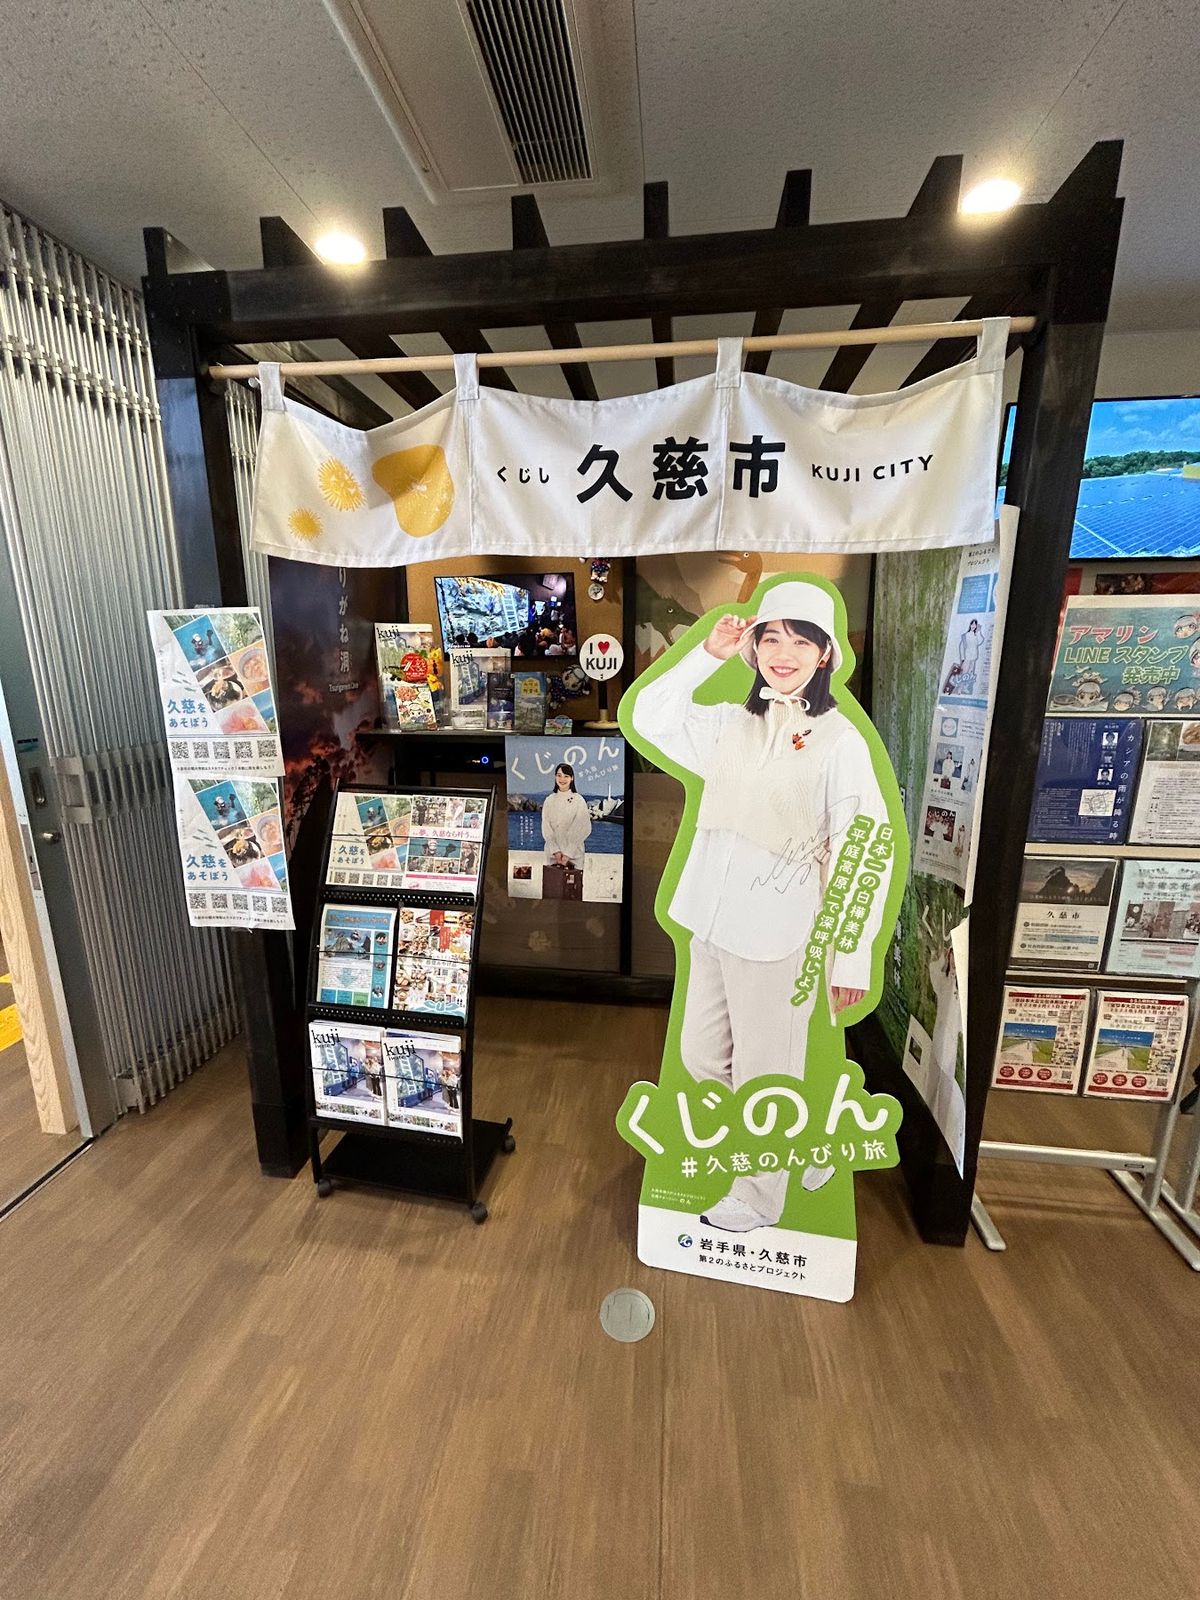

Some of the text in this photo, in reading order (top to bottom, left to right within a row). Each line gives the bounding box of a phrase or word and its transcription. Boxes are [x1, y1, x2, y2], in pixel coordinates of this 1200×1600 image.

[496, 434, 934, 504] くじし 久慈市 KUJI CITY
[376, 625, 401, 640] kuji
[1068, 624, 1160, 645] アマリン
[451, 650, 473, 665] kuji
[589, 642, 593, 655] I
[1063, 644, 1190, 665] LINE スタンプ
[585, 657, 617, 671] KUJI
[1121, 665, 1181, 686] 発売中
[167, 698, 207, 714] 久慈を
[169, 717, 208, 728] あそぼう
[511, 737, 619, 780] くじのん
[338, 845, 365, 856] 久慈を
[186, 854, 227, 868] 久慈を
[337, 856, 365, 864] あそぼう
[187, 871, 229, 881] あそぼう
[838, 828, 893, 950] 日本一の白樺美林
[311, 1028, 341, 1047] kuji
[384, 1040, 417, 1058] kuji
[628, 1073, 889, 1155] くじのん
[681, 1139, 888, 1178] #久慈のんびり旅
[699, 1238, 807, 1268] 岩手県・久慈市
[699, 1254, 806, 1280] 第2のふるさとプロジェクト
